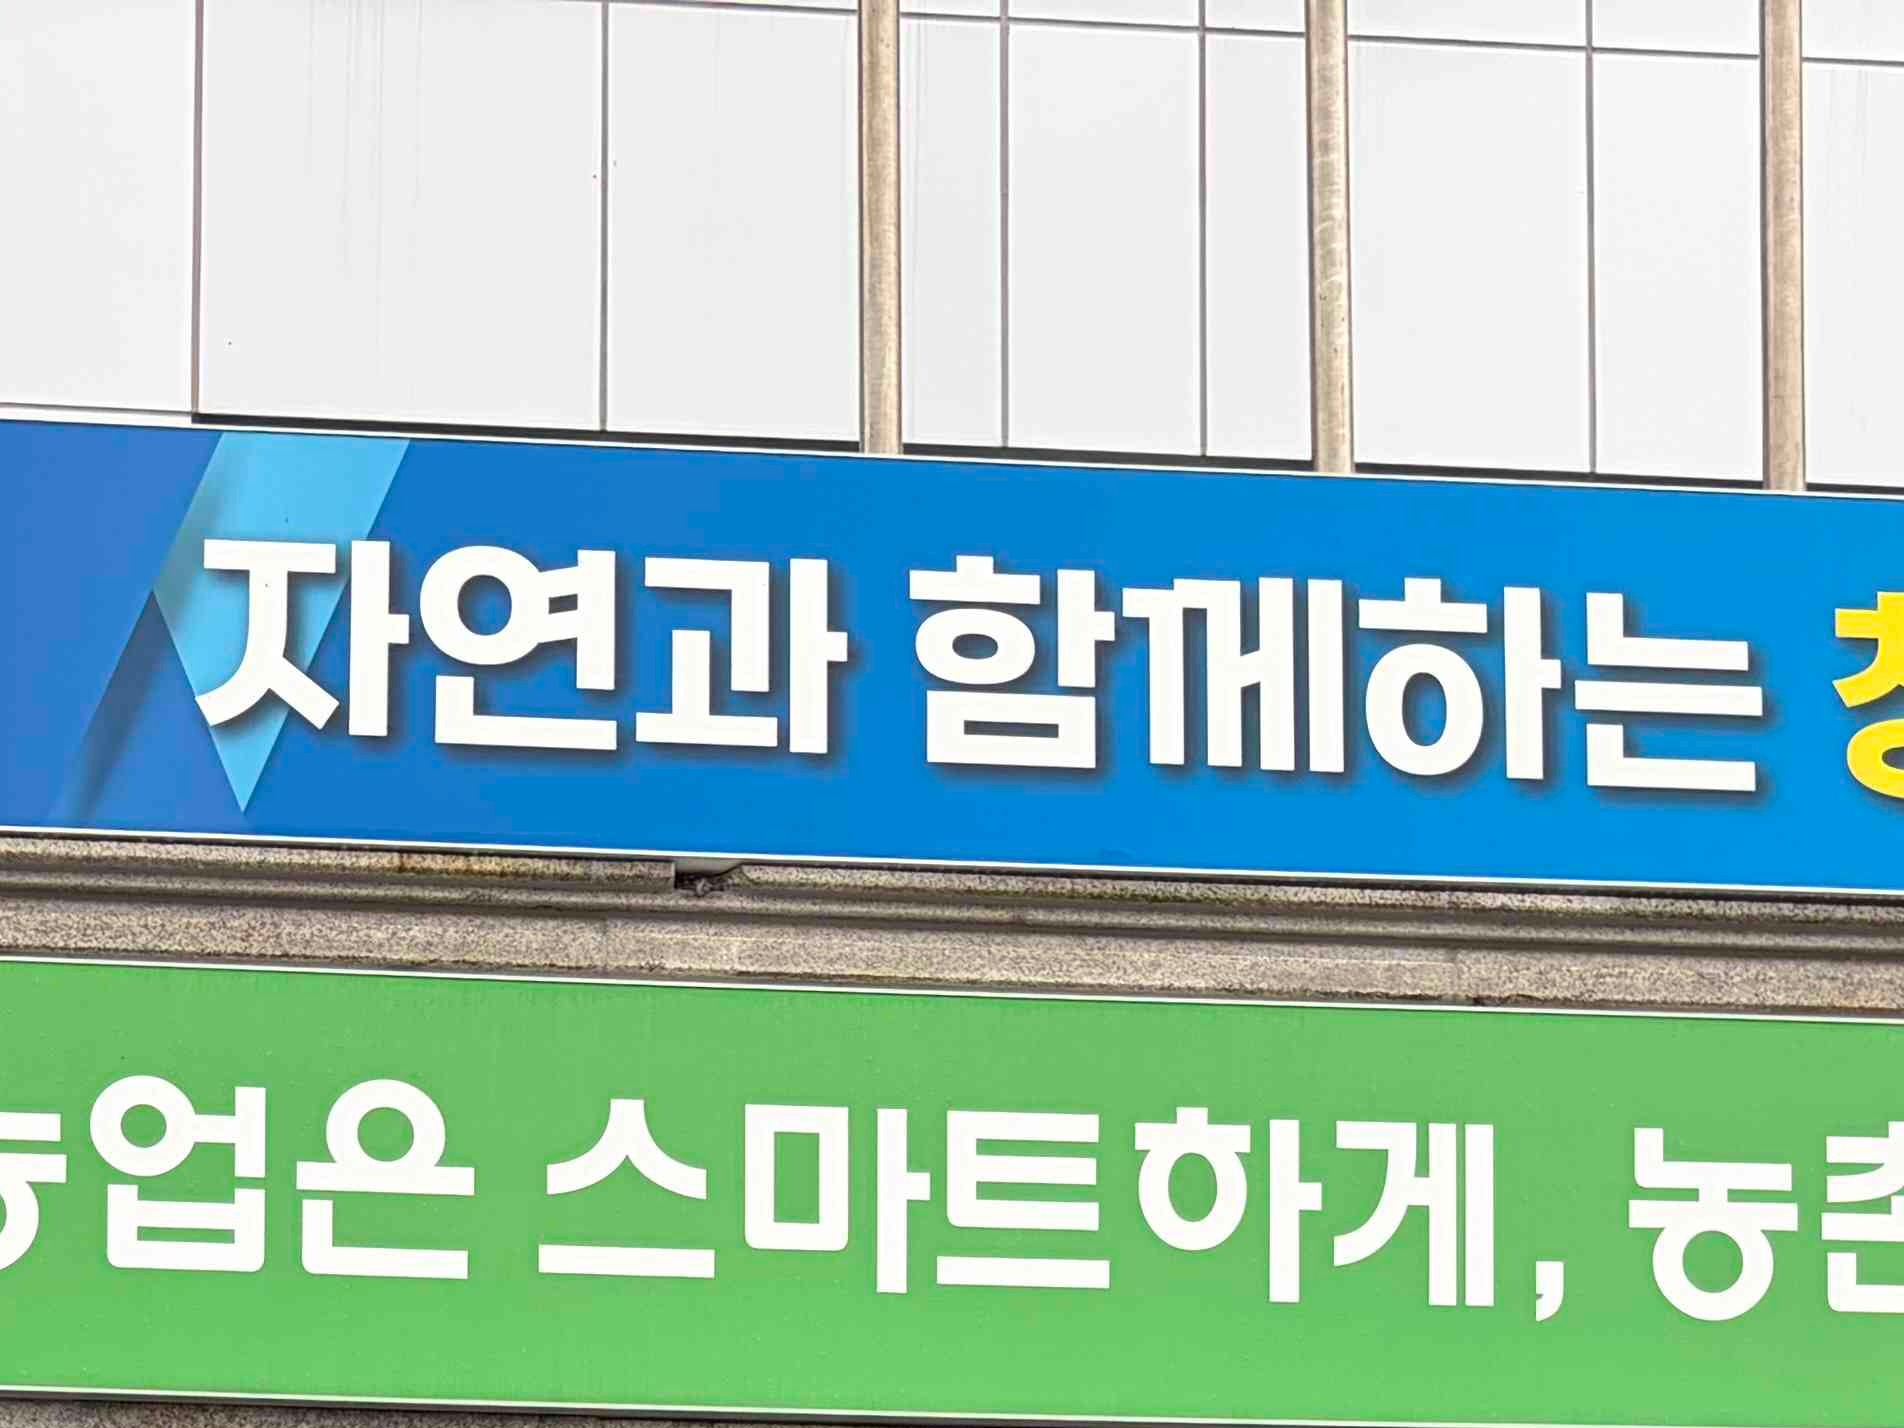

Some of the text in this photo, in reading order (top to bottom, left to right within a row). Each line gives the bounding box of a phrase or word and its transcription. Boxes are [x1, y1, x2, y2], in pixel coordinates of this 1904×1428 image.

[196, 537, 847, 762] 자연과
[908, 556, 1764, 796] 함께하는
[538, 1096, 1564, 1323] 스마트하게,
